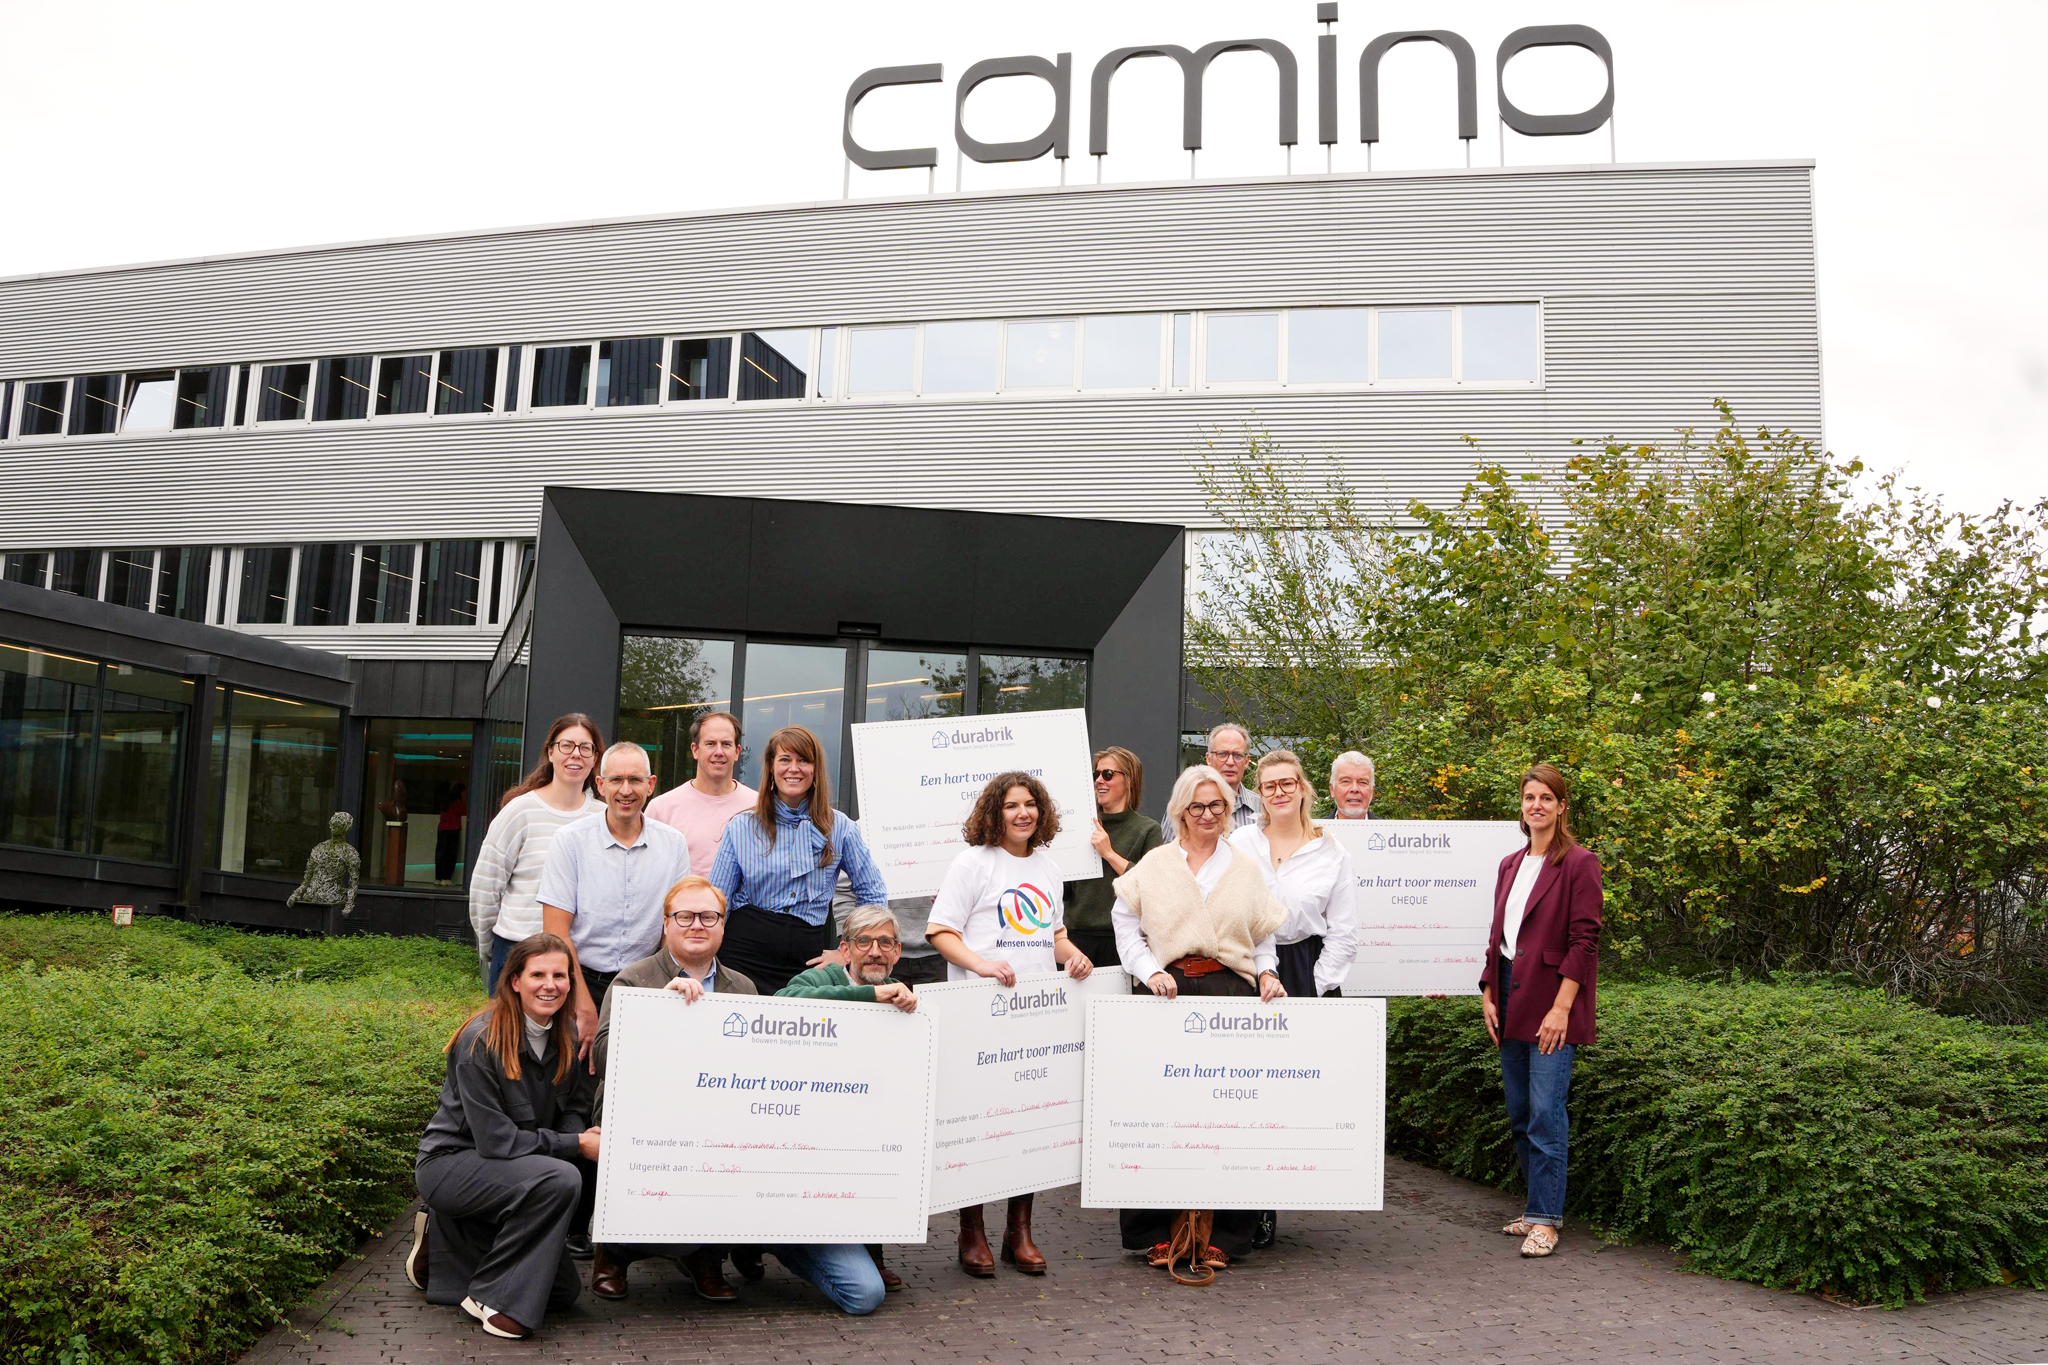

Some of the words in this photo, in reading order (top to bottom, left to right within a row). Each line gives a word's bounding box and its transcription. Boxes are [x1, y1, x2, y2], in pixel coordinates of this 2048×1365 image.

[843, 2, 1615, 171] camino
[952, 726, 1014, 744] durabrik
[920, 775, 942, 786] Een
[944, 773, 970, 784] hart
[972, 772, 998, 782] voor
[892, 824, 914, 832] waarde
[884, 841, 912, 850] Uitgereikt
[1388, 833, 1451, 848] durabrik
[1376, 876, 1402, 888] hart
[1404, 879, 1431, 888] voor
[1434, 879, 1477, 888] mensen
[1392, 896, 1428, 906] CHEQUE
[996, 939, 1026, 948] Mensen
[1010, 988, 1067, 1011] durabrik
[751, 1014, 838, 1038] durabrik
[1209, 1012, 1288, 1031] durabrik
[780, 1038, 801, 1046] begint
[803, 1039, 811, 1047] bij
[977, 1052, 997, 1065] Een
[1000, 1048, 1024, 1062] hart
[1026, 1046, 1050, 1058] voor
[1052, 1040, 1085, 1054] mense
[1015, 1067, 1048, 1082] CHEQUE
[1163, 1064, 1190, 1078] Een
[1194, 1064, 1226, 1078] hart
[1229, 1068, 1263, 1078] voor
[1266, 1069, 1321, 1079] mensen
[696, 1072, 727, 1089] Een
[730, 1073, 767, 1090] hart
[770, 1080, 807, 1091] voor
[810, 1081, 869, 1094] mensen
[1213, 1088, 1258, 1100] CHEQUE
[750, 1102, 801, 1117] CHEQUE
[936, 1118, 946, 1126] Ter
[946, 1115, 968, 1124] waarde
[632, 1137, 644, 1146] Ter
[647, 1138, 677, 1146] waarde
[936, 1138, 964, 1149] Uitgereikt
[1108, 1141, 1145, 1149] Uitgereikt
[882, 1144, 902, 1152] EURO
[629, 1162, 670, 1172] Uitgereikt
[673, 1164, 688, 1172] aan
